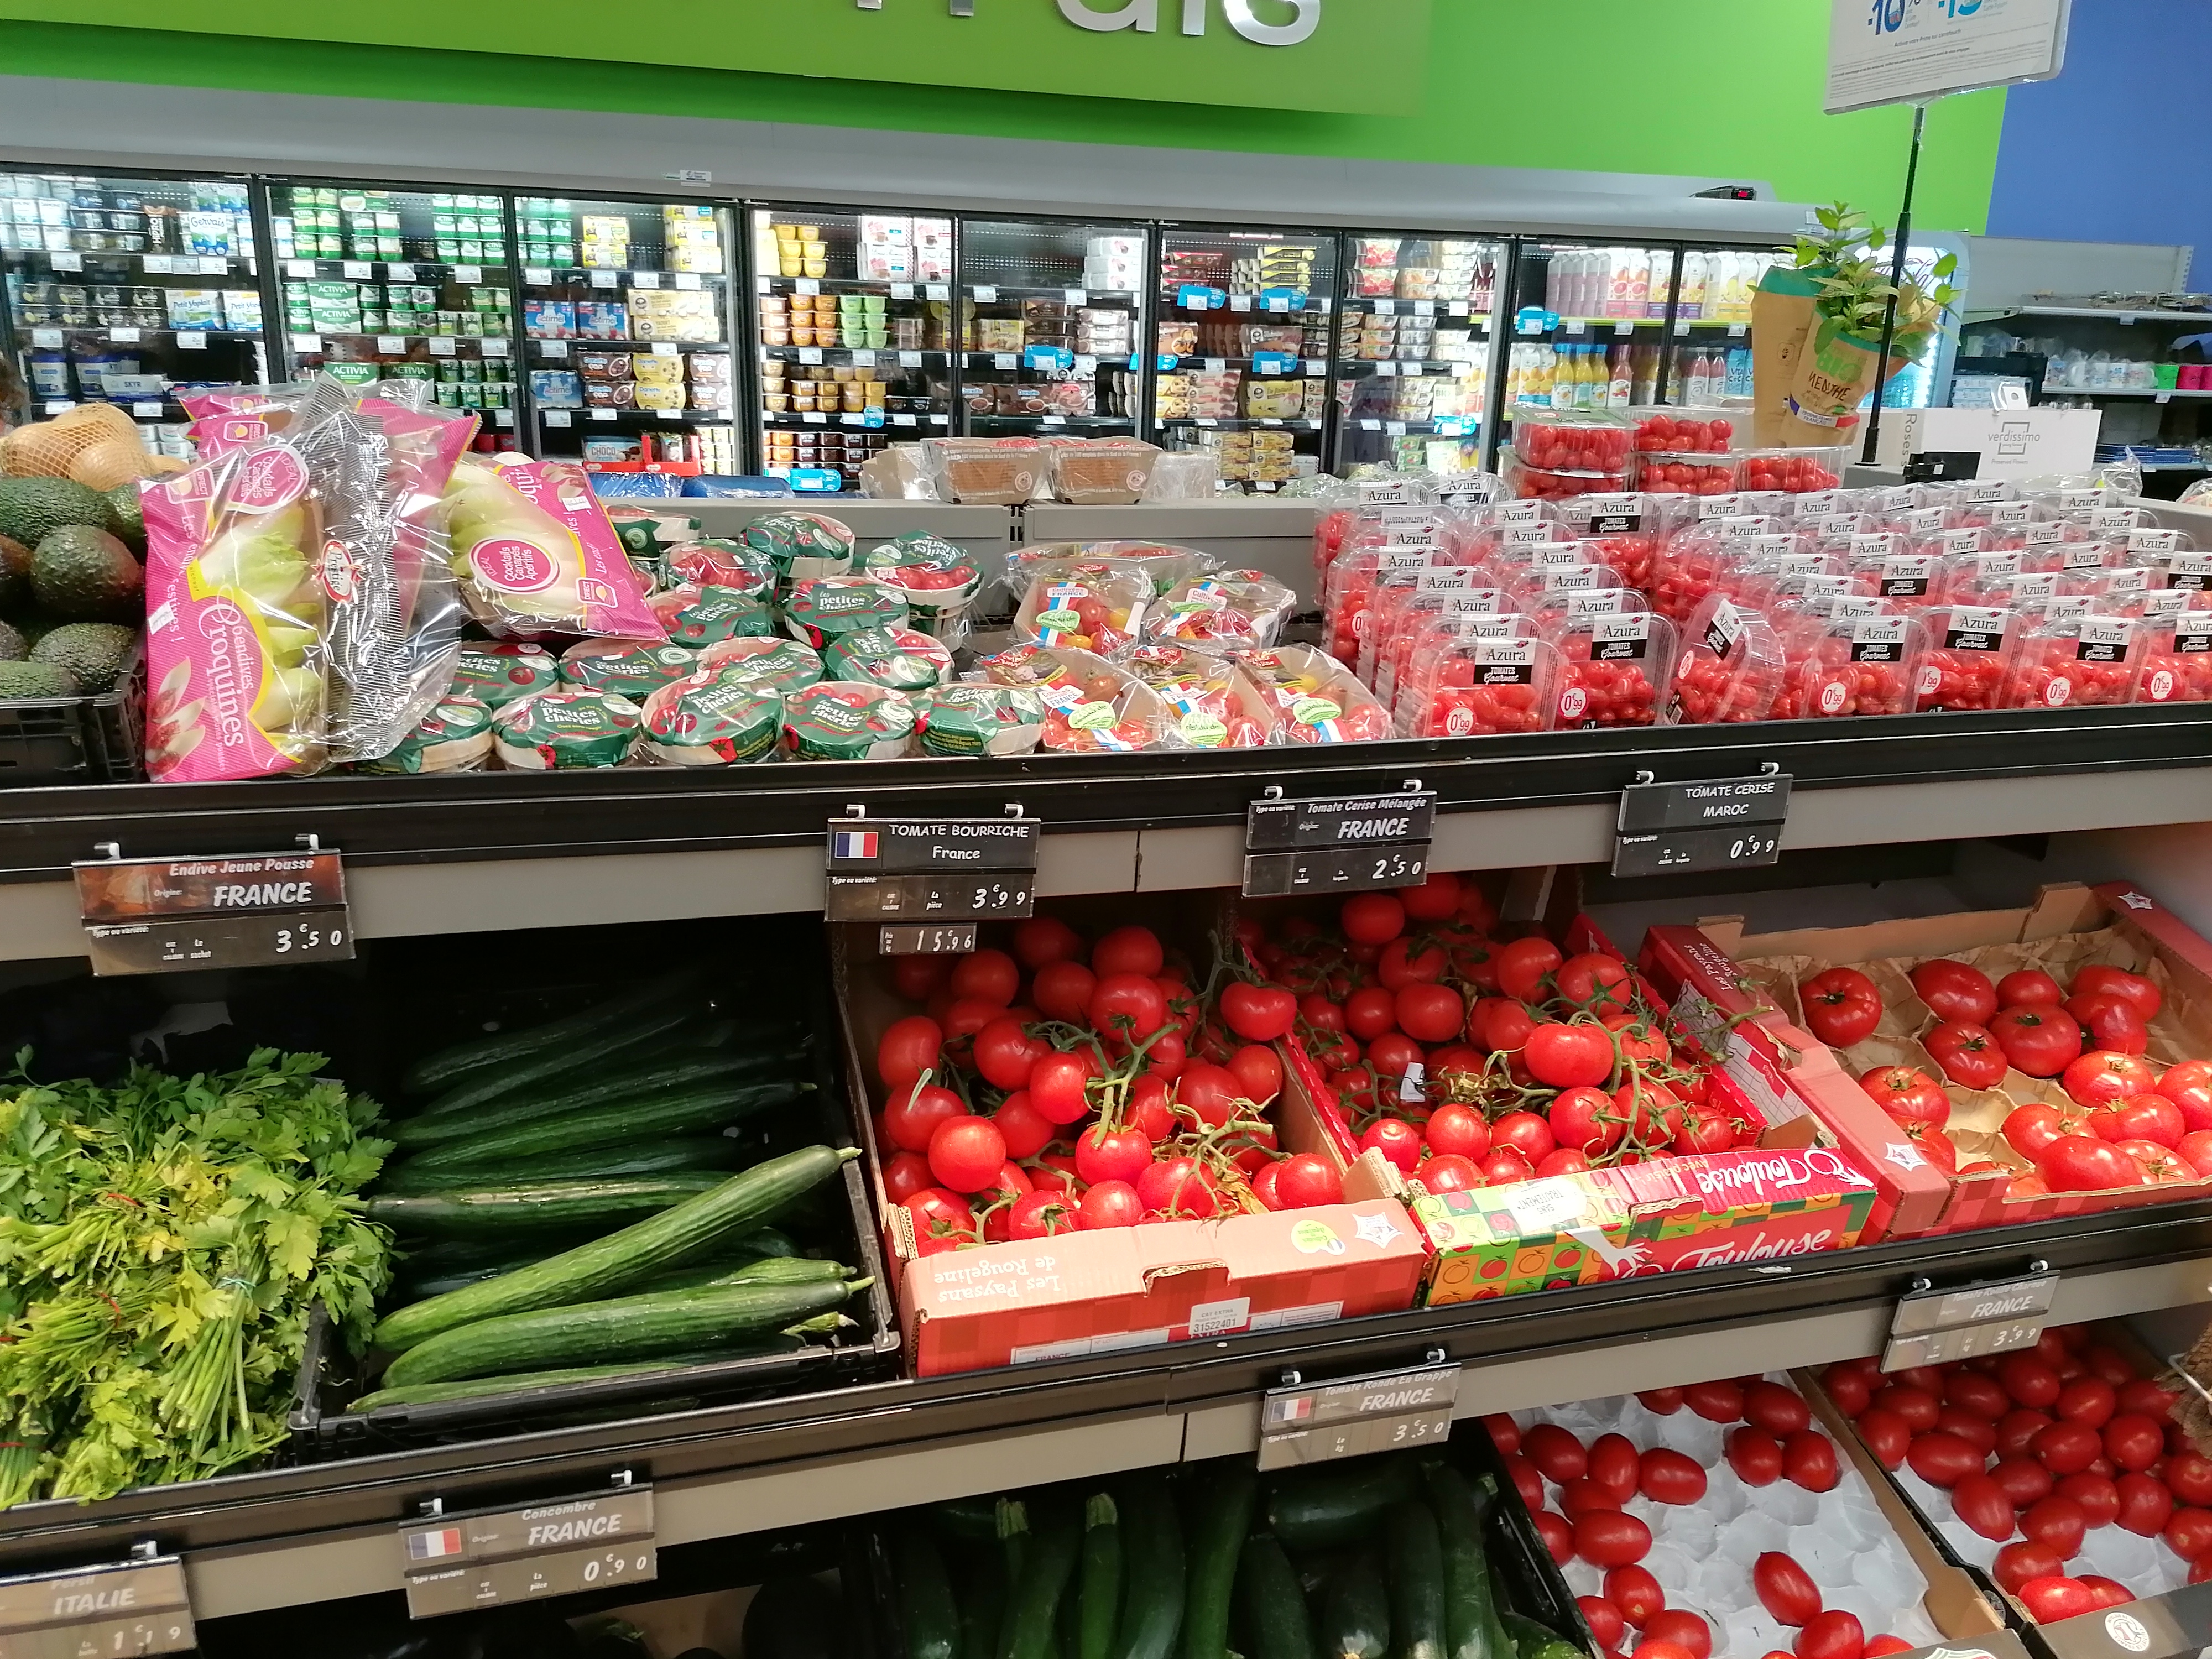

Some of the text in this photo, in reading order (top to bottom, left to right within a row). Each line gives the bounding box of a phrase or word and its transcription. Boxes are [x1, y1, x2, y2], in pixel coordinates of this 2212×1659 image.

[191, 217, 225, 227] Gervais
[392, 367, 426, 375] ACTIVIA
[1988, 430, 2041, 442] verdissimo
[591, 446, 615, 456] CHOCO
[197, 471, 208, 495] DIRECT
[262, 457, 273, 497] Cocktails
[1449, 479, 1481, 491] Azura
[1367, 489, 1401, 501] Azura
[1974, 488, 2001, 499] Azura
[1601, 501, 1634, 513] Azura
[1802, 501, 1830, 513] Azura
[1888, 496, 1911, 507] Azura
[1503, 510, 1535, 521] Azura
[1707, 504, 1736, 515] Azura
[1826, 521, 1855, 534] Azura
[1916, 517, 1940, 529] Azura
[1396, 533, 1431, 545] Azura
[1512, 531, 1545, 542] Azura
[1858, 540, 1887, 554] Azura
[1950, 539, 1975, 550] Azura
[512, 546, 522, 580] Canapés
[1387, 556, 1424, 568] Azura
[1541, 551, 1574, 563] Azura
[499, 547, 515, 581] Cocktails
[523, 549, 536, 580] Apéritifs
[1985, 561, 2015, 572] Azura
[328, 551, 342, 592] Prestige
[1427, 577, 1464, 589] Azura
[2020, 583, 2050, 595] Azura
[820, 590, 831, 598] les
[820, 596, 865, 606] petites
[1578, 598, 1614, 613] Azura
[1718, 612, 1735, 638] Azura
[1959, 615, 1999, 630] Azura
[1470, 625, 1508, 637] Azura
[1604, 625, 1640, 637] Azura
[1863, 625, 1898, 642] Azura
[1486, 648, 1526, 661] Azura
[199, 583, 244, 747] Croquines
[1484, 673, 1519, 684] Gourmet
[1050, 692, 1080, 707] FRANCE
[542, 707, 597, 717] petites
[545, 714, 601, 725] chéries
[1686, 782, 1776, 798] TOMATE CERISE
[1307, 797, 1427, 813] Tomate Cerise Mélangée
[1703, 804, 1749, 818] MAROC
[889, 824, 1029, 838] TOMATE BOURRICHE
[1337, 817, 1410, 839] FRANCE
[932, 846, 980, 860] France
[170, 858, 314, 877] Endive Jeune Pousse
[832, 877, 846, 885] Type
[212, 881, 312, 907] FRANCE
[926, 900, 942, 911] pièce
[1684, 945, 1718, 975] Paysans
[1682, 1159, 1709, 1171] Avec
[1699, 1151, 1810, 1196] Toulouse
[1540, 1204, 1556, 1214] SANS
[934, 1256, 1056, 1285] de Rougeline
[939, 1275, 1061, 1303] Les Paysans
[1970, 1296, 2033, 1318] FRANCE
[1193, 1318, 1236, 1332] 31522401
[1035, 1352, 1070, 1361] FRANCE
[1325, 1370, 1452, 1396] Tomate Ronde En Grappe
[1359, 1387, 1434, 1412] FRANCE
[521, 1502, 596, 1521] Concombre
[528, 1514, 622, 1545] FRANCE
[412, 1575, 430, 1584] Type
[530, 1581, 547, 1592] pièce
[54, 1588, 135, 1615] ITALIE
